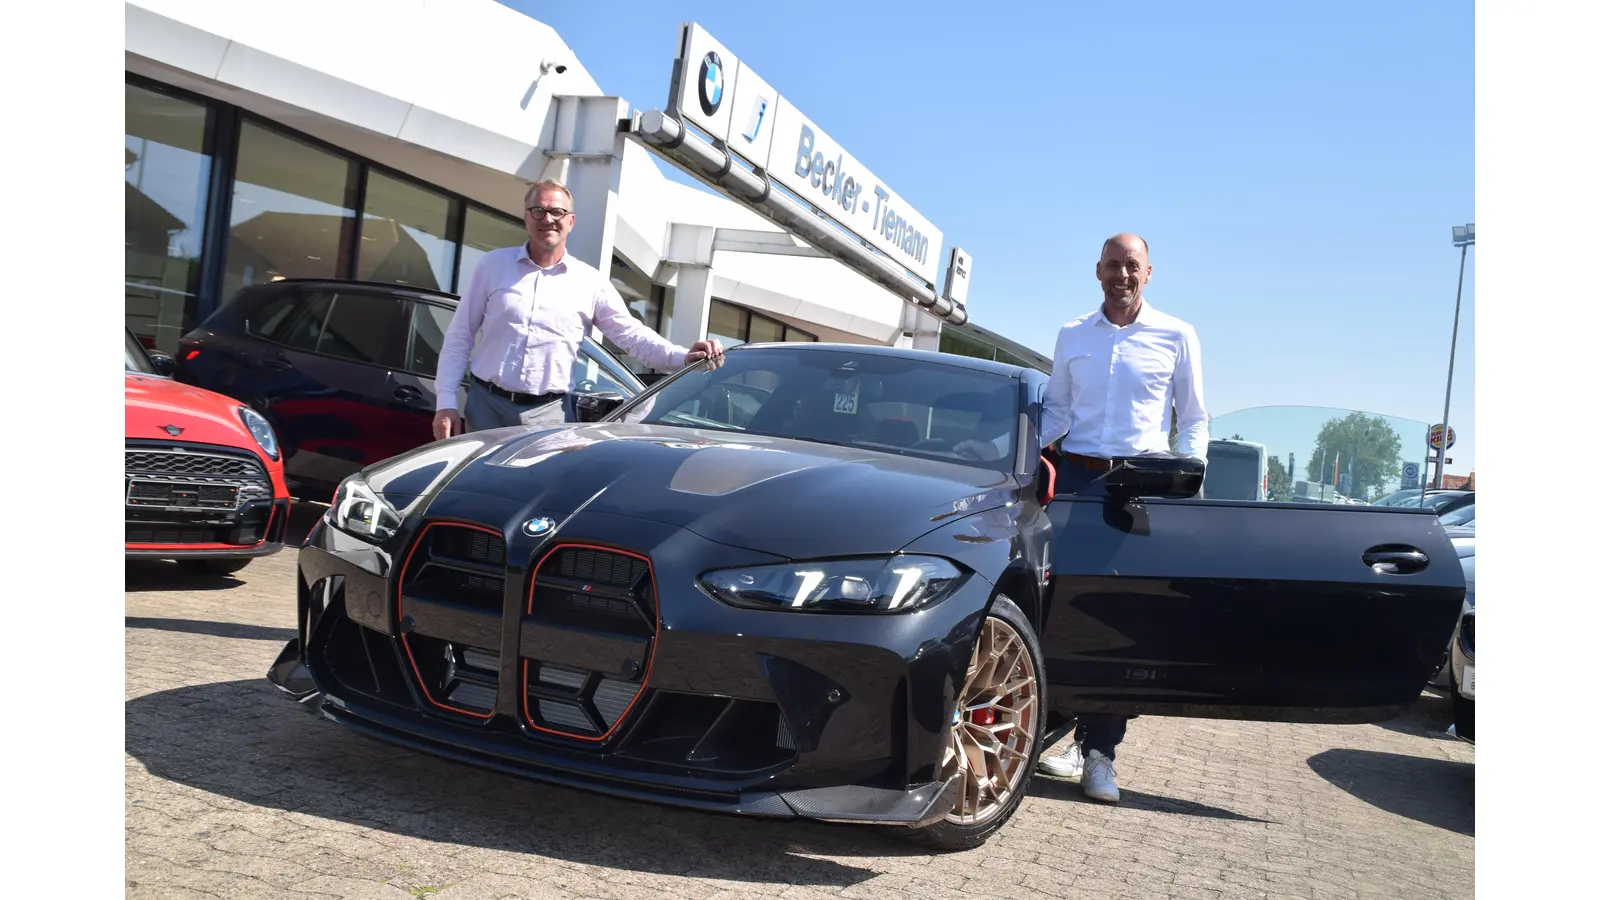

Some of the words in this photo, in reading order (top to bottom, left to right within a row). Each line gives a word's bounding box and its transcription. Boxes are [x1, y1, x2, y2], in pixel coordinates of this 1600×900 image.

[795, 122, 862, 215] Becker
[873, 185, 929, 266] Tiemann
[835, 393, 856, 412] 225
